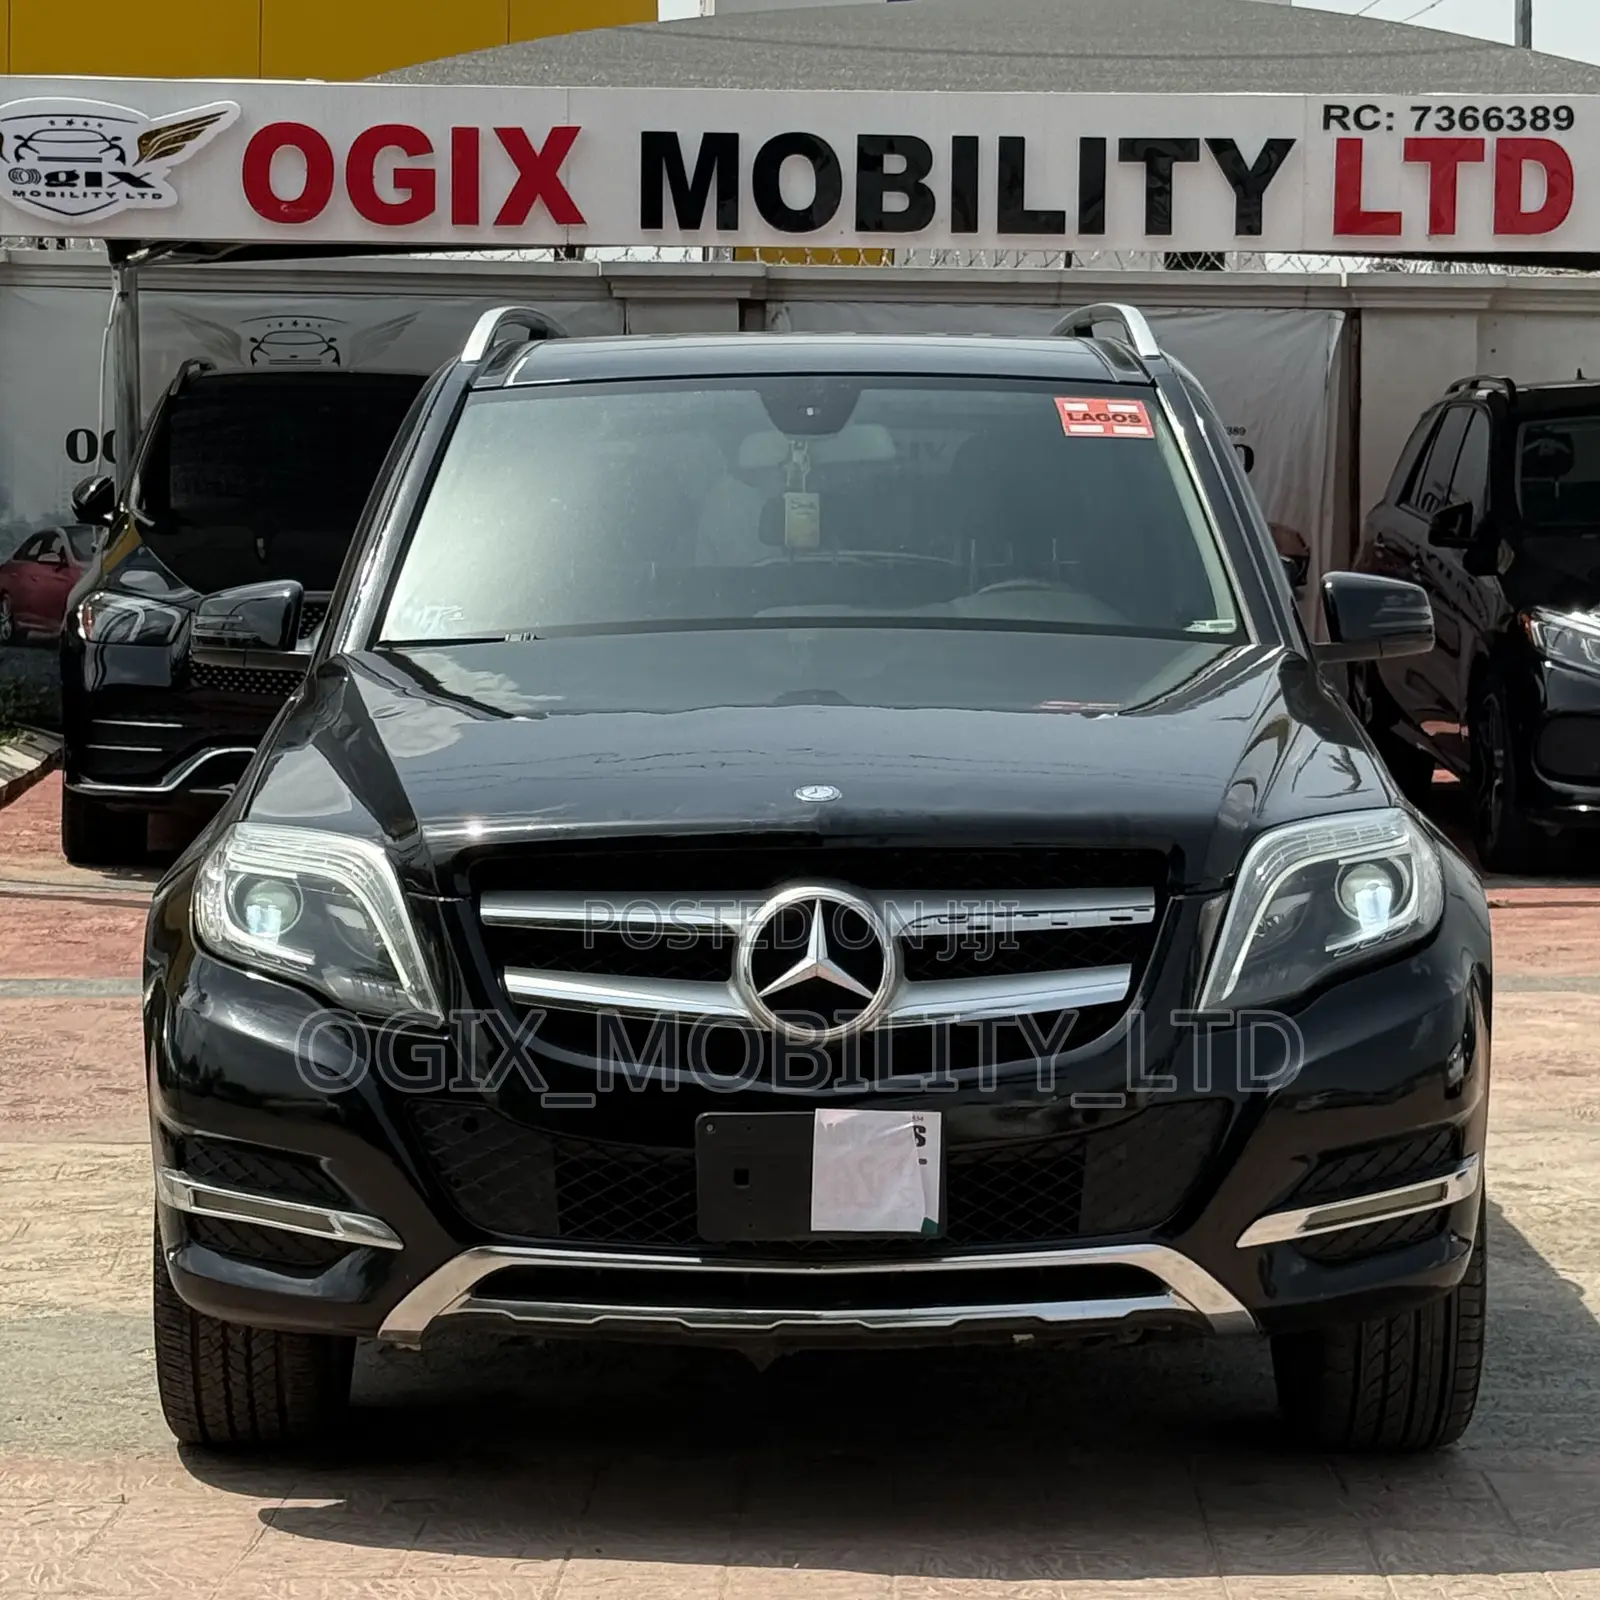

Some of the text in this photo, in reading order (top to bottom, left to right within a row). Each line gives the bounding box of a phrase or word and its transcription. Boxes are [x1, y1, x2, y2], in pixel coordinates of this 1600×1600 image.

[1322, 103, 1575, 132] RC: 7366389
[241, 121, 1575, 236] OGIX MOBILITY LTD
[12, 189, 164, 200] MOBILITY LTD
[1066, 411, 1142, 424] LAGOS
